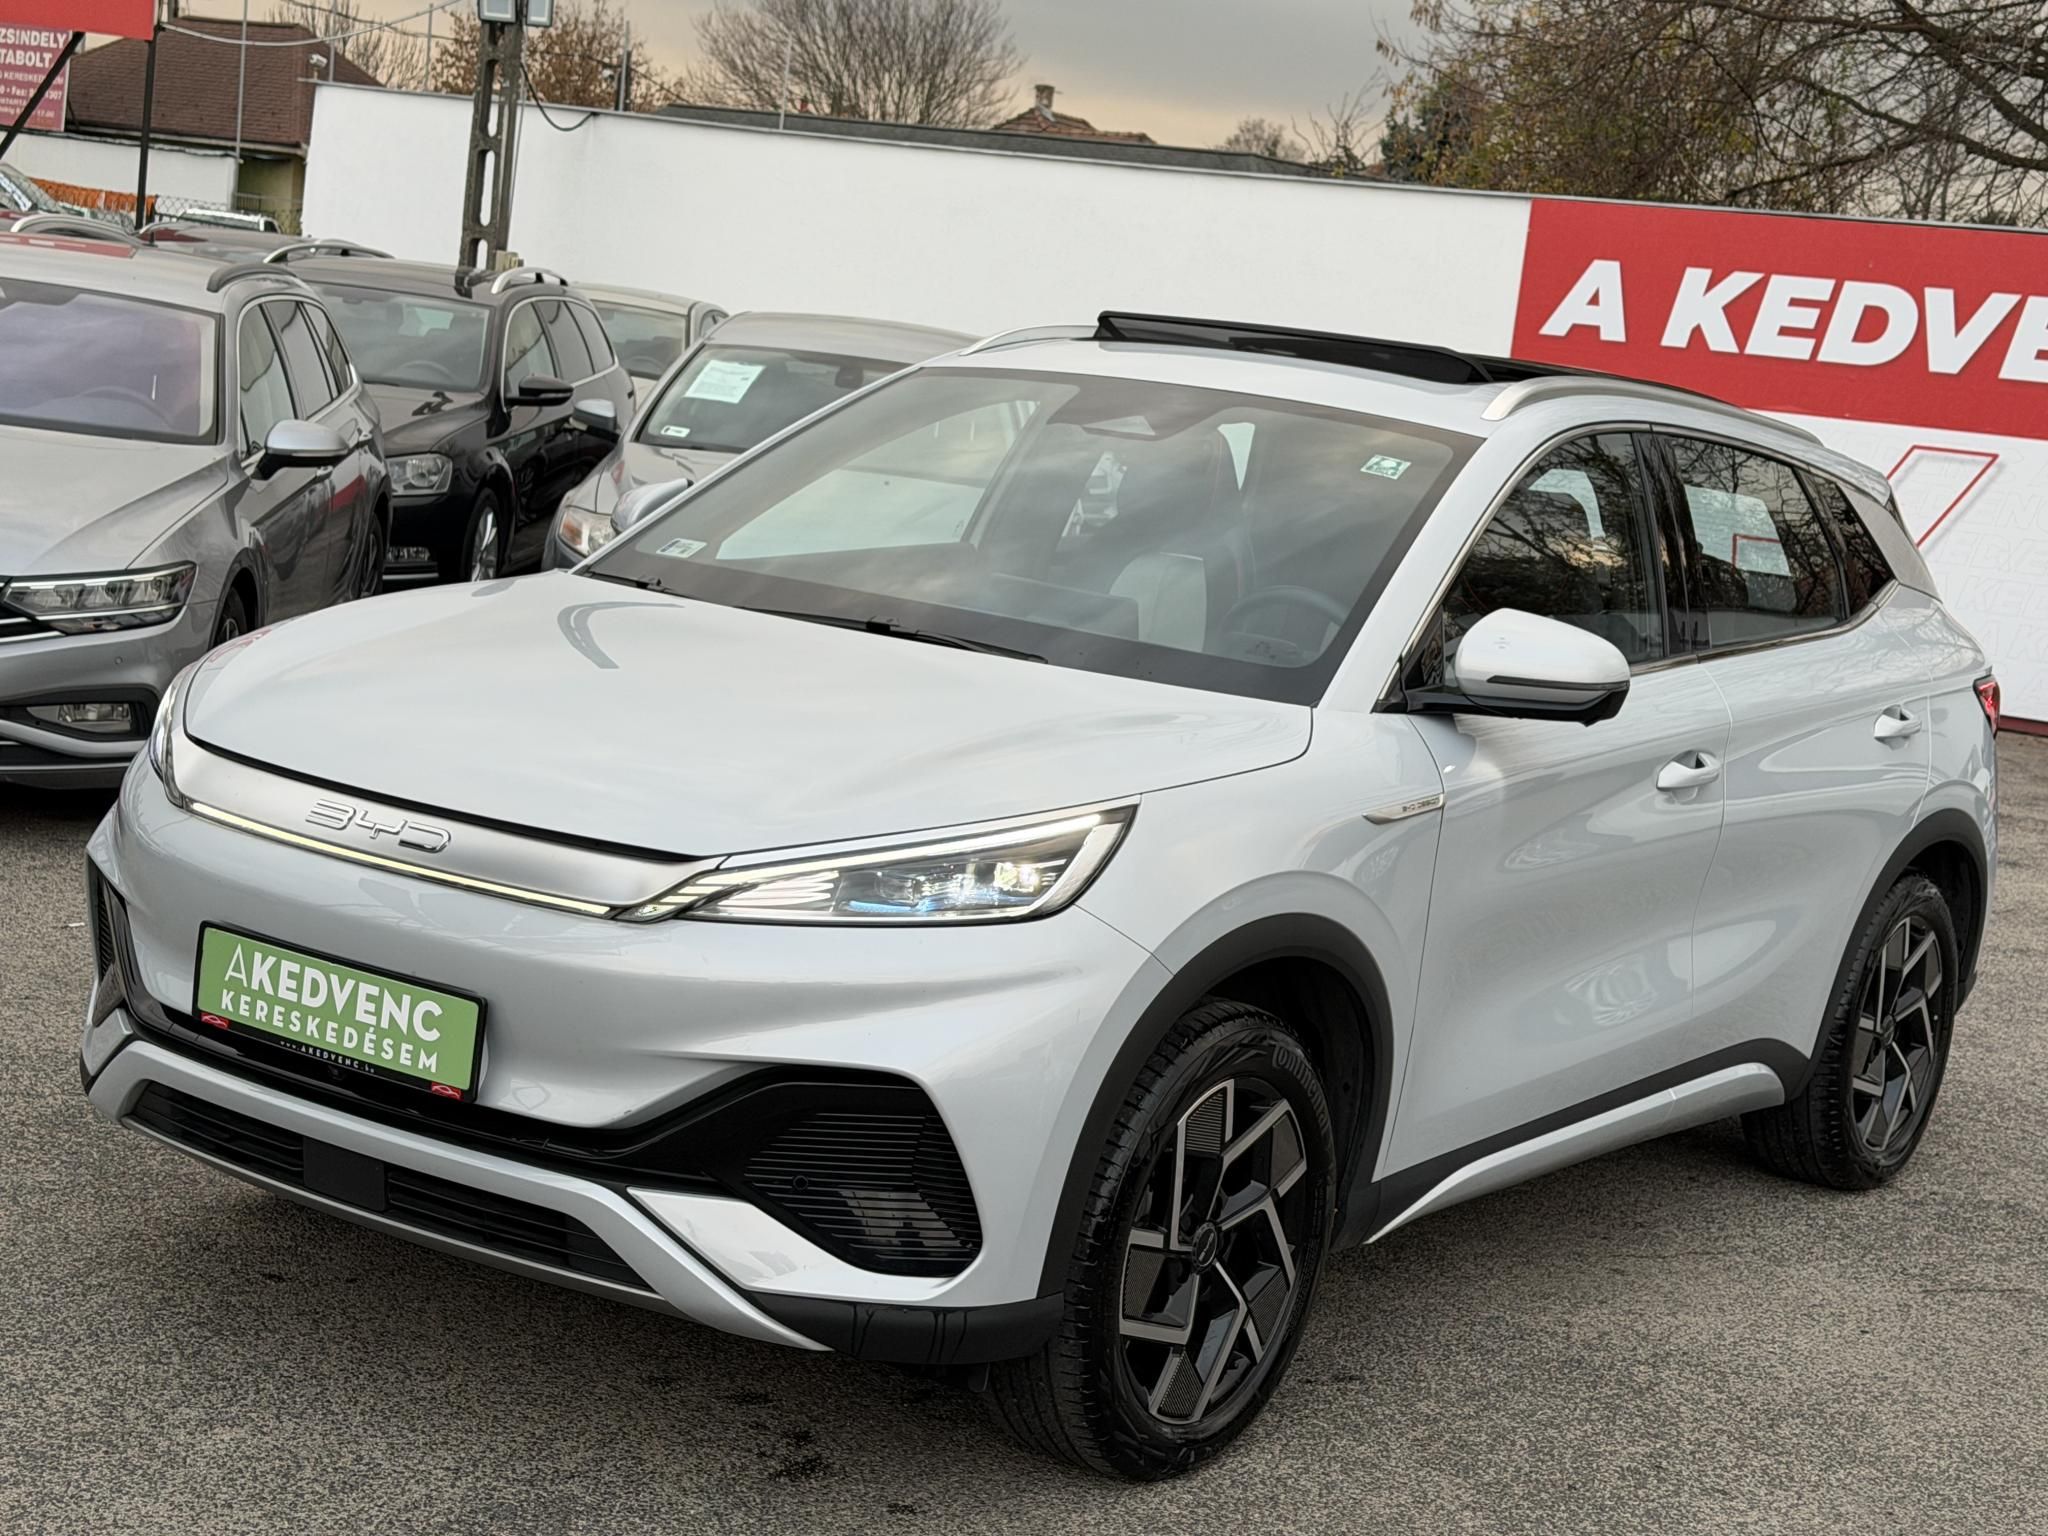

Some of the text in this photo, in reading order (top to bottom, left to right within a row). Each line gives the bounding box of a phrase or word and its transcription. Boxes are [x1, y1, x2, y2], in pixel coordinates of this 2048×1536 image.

[0, 27, 67, 49] ZSINDELY
[0, 48, 52, 68] TABOLT
[1538, 258, 1627, 343] A
[305, 798, 452, 854] BYD
[221, 989, 438, 1073] KERESKEDÉSEM
